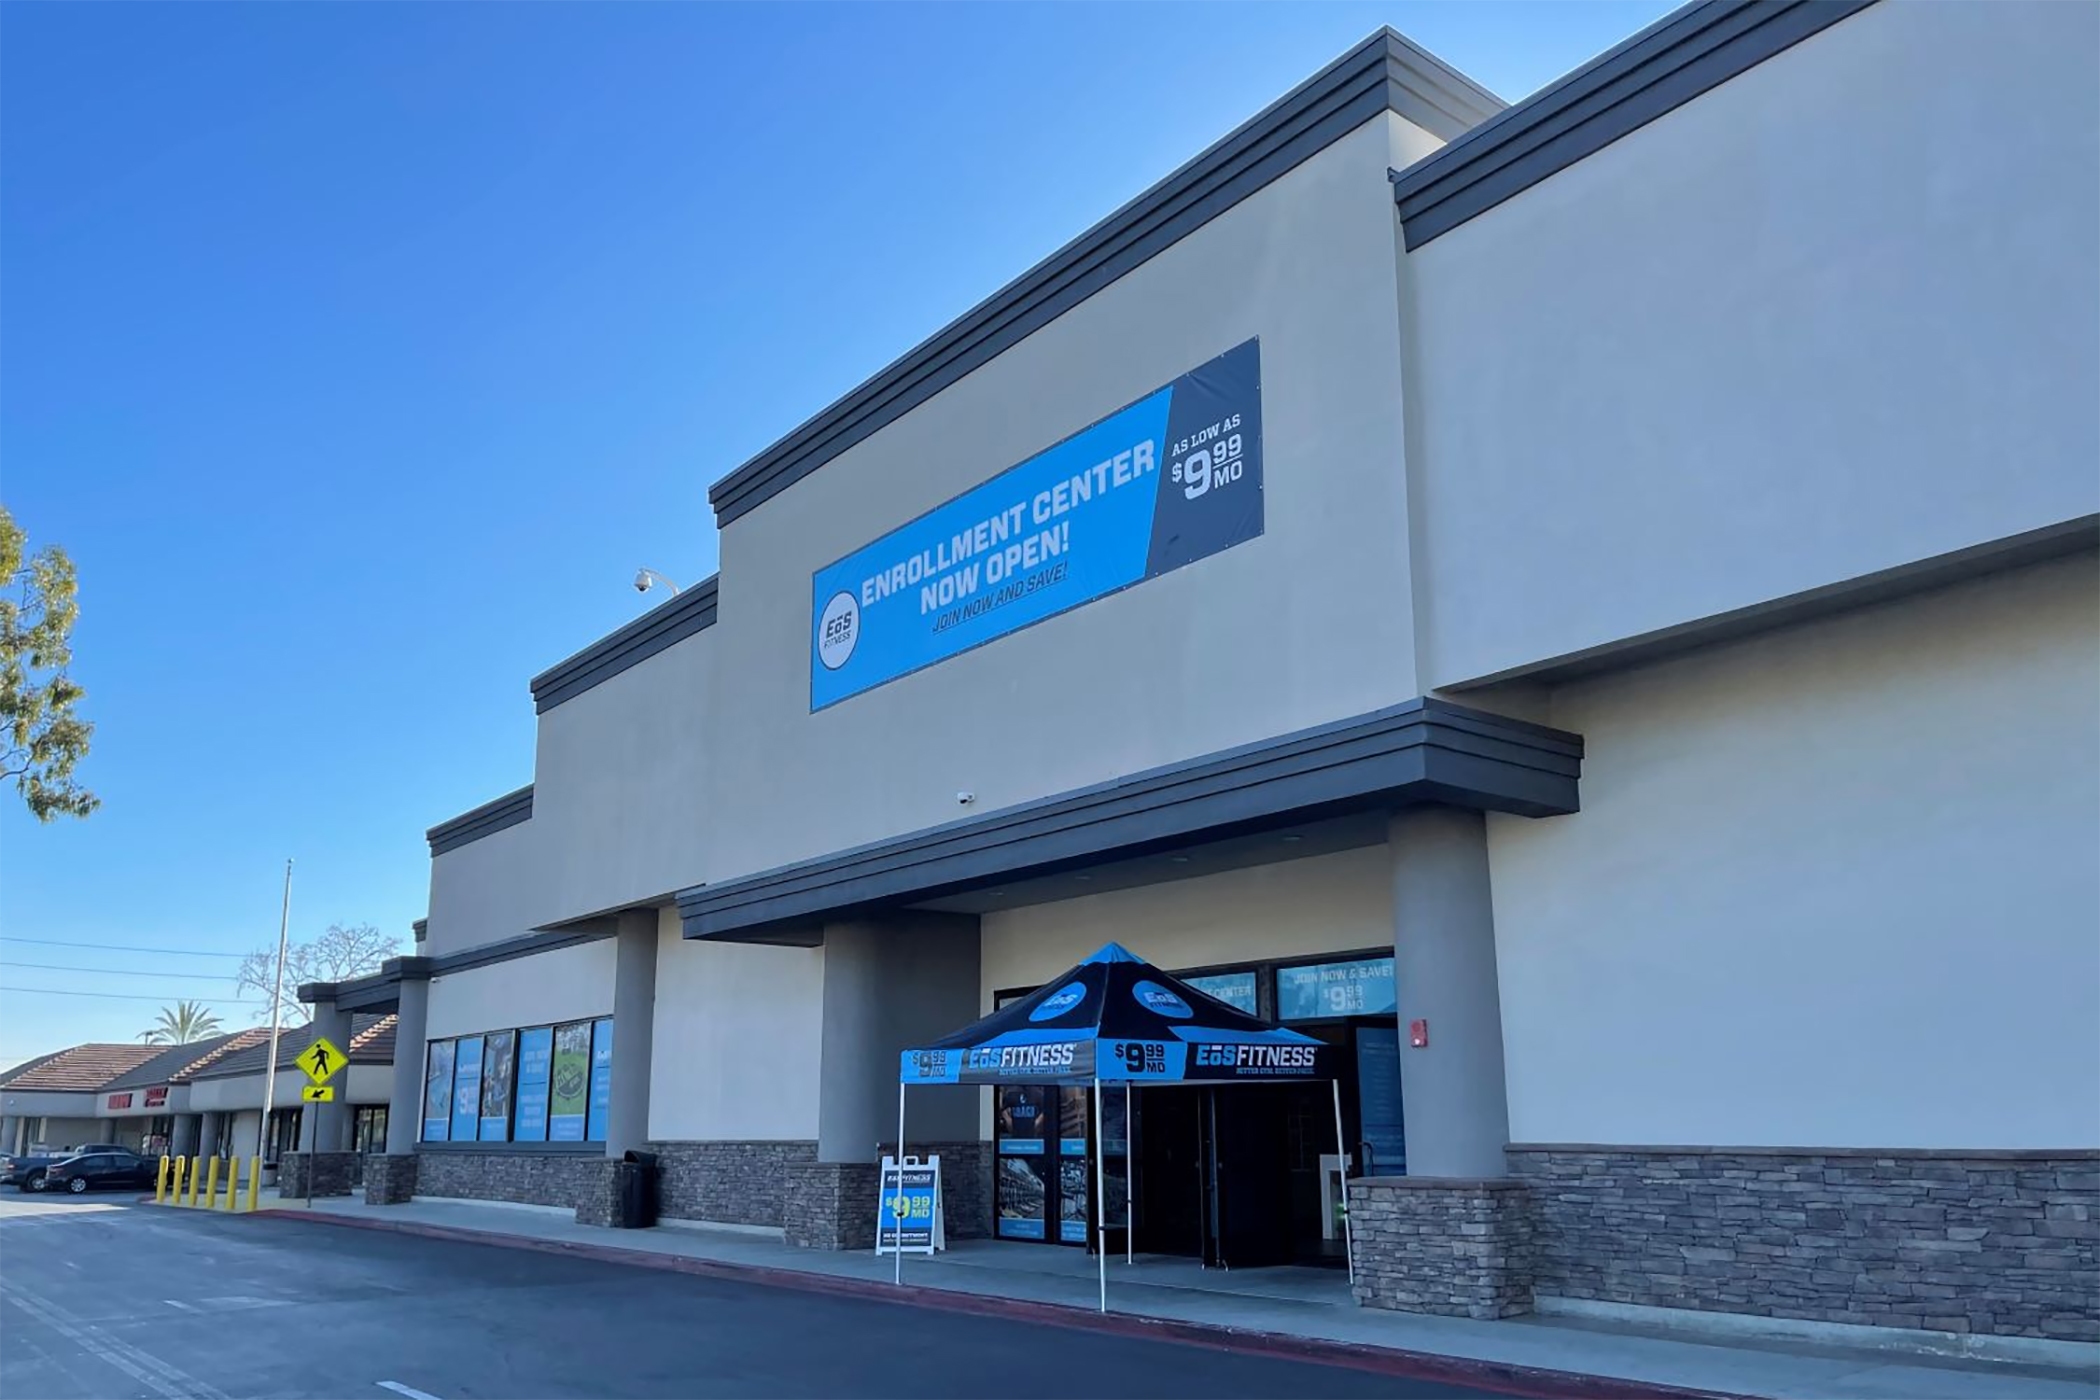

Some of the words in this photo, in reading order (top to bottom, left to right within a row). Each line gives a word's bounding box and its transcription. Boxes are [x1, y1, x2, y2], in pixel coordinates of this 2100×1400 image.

[1172, 439, 1188, 457] AS
[1191, 422, 1220, 448] LOW
[1223, 413, 1240, 433] AS
[1214, 460, 1242, 489] MO
[862, 502, 1027, 608] ENROLLMENT
[1032, 439, 1155, 525] CENTER
[921, 562, 980, 615] NOW
[986, 521, 1069, 585] OPEN!
[933, 610, 961, 632] JOIN
[963, 594, 993, 619] NOW
[995, 582, 1023, 608] AND
[1027, 561, 1068, 593] SAVE!
[824, 630, 851, 649] FITNESS
[1294, 973, 1317, 984] JOIN
[1321, 969, 1346, 982] NOW
[1349, 968, 1357, 979] &
[1146, 1061, 1166, 1074] MO
